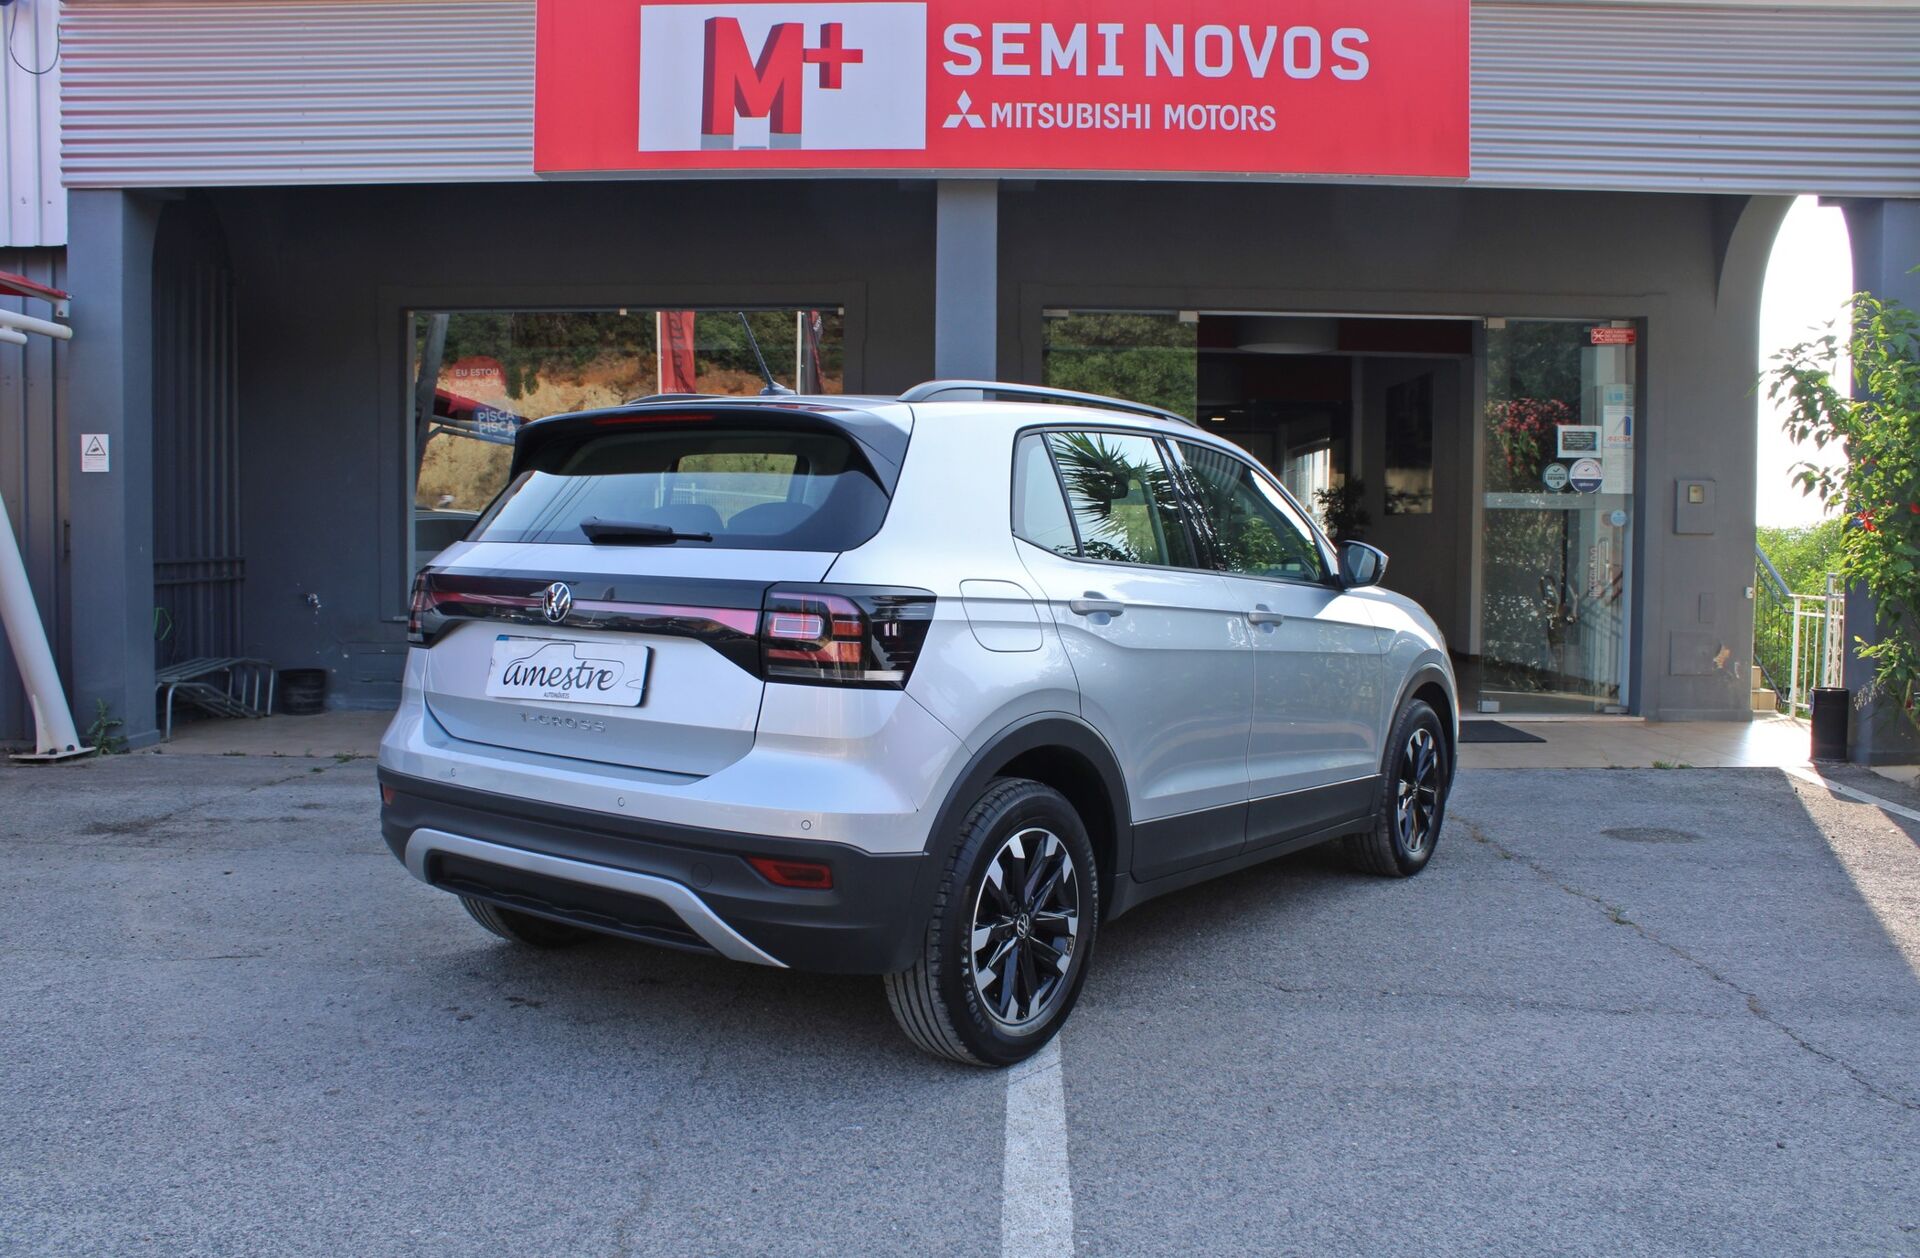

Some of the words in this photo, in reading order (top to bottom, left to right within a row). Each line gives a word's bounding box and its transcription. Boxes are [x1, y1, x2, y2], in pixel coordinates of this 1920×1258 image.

[943, 23, 1124, 76] SEMI
[1145, 24, 1370, 80] NOVOS
[991, 102, 1151, 129] MITSUBISHI
[1164, 104, 1277, 131] MOTORS
[471, 368, 499, 376] ESTOU
[503, 661, 614, 690] amestre
